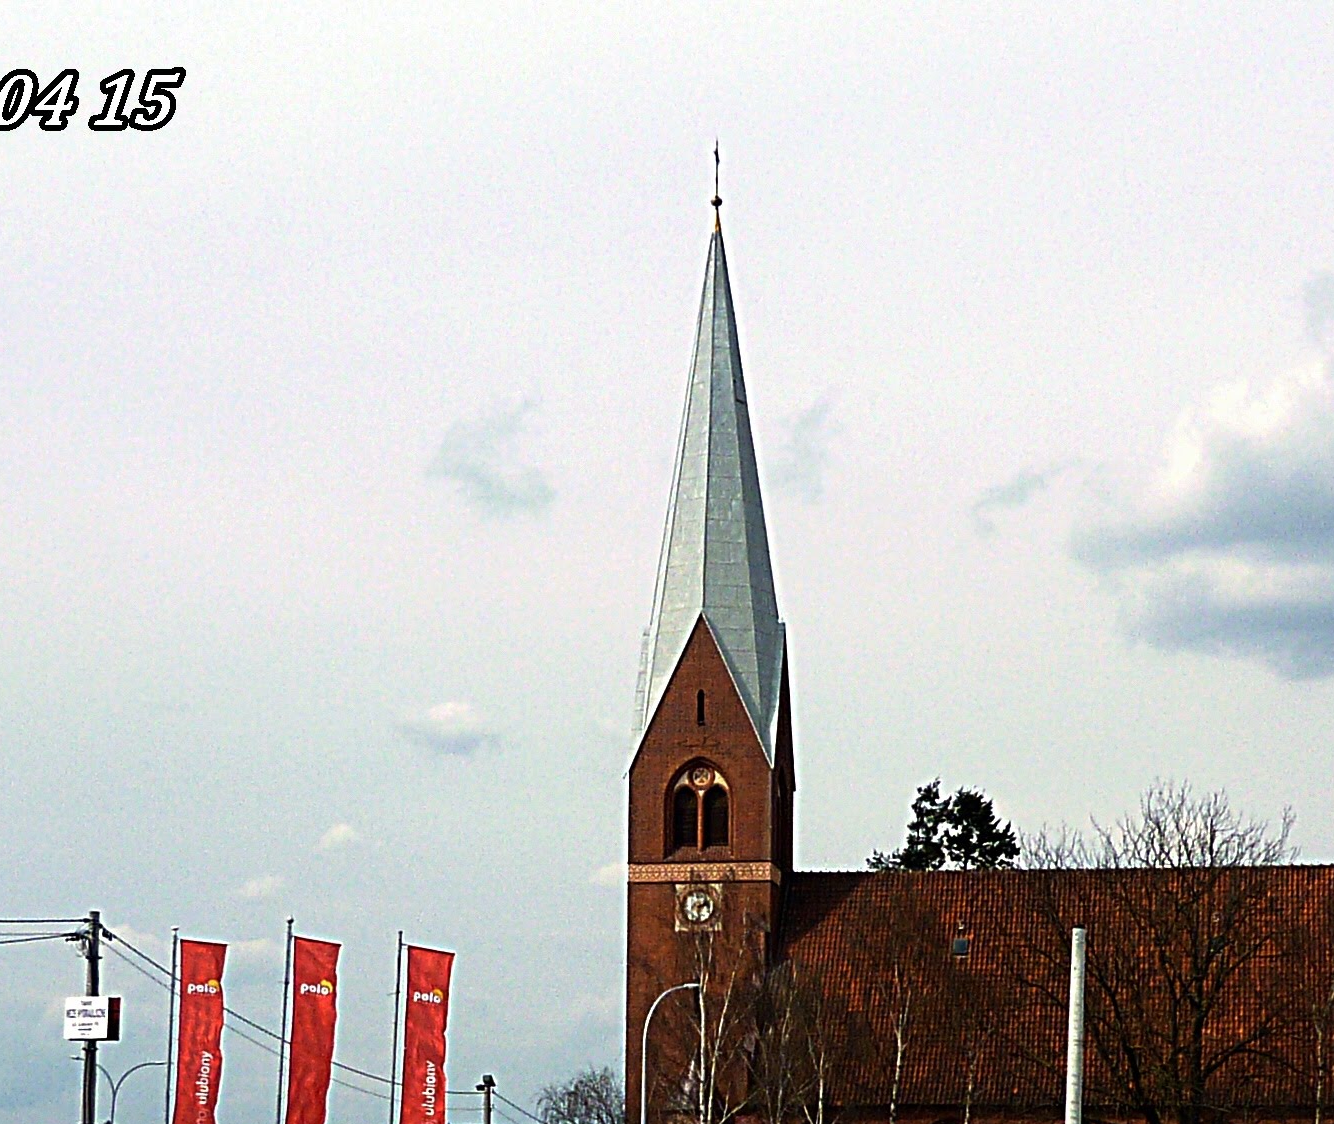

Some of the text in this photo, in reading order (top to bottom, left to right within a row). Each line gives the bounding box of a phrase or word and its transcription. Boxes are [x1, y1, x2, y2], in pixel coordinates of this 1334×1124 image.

[188, 982, 217, 994] polo
[300, 983, 329, 995] polo
[413, 991, 441, 1004] polo
[196, 1050, 214, 1105] ulubiony
